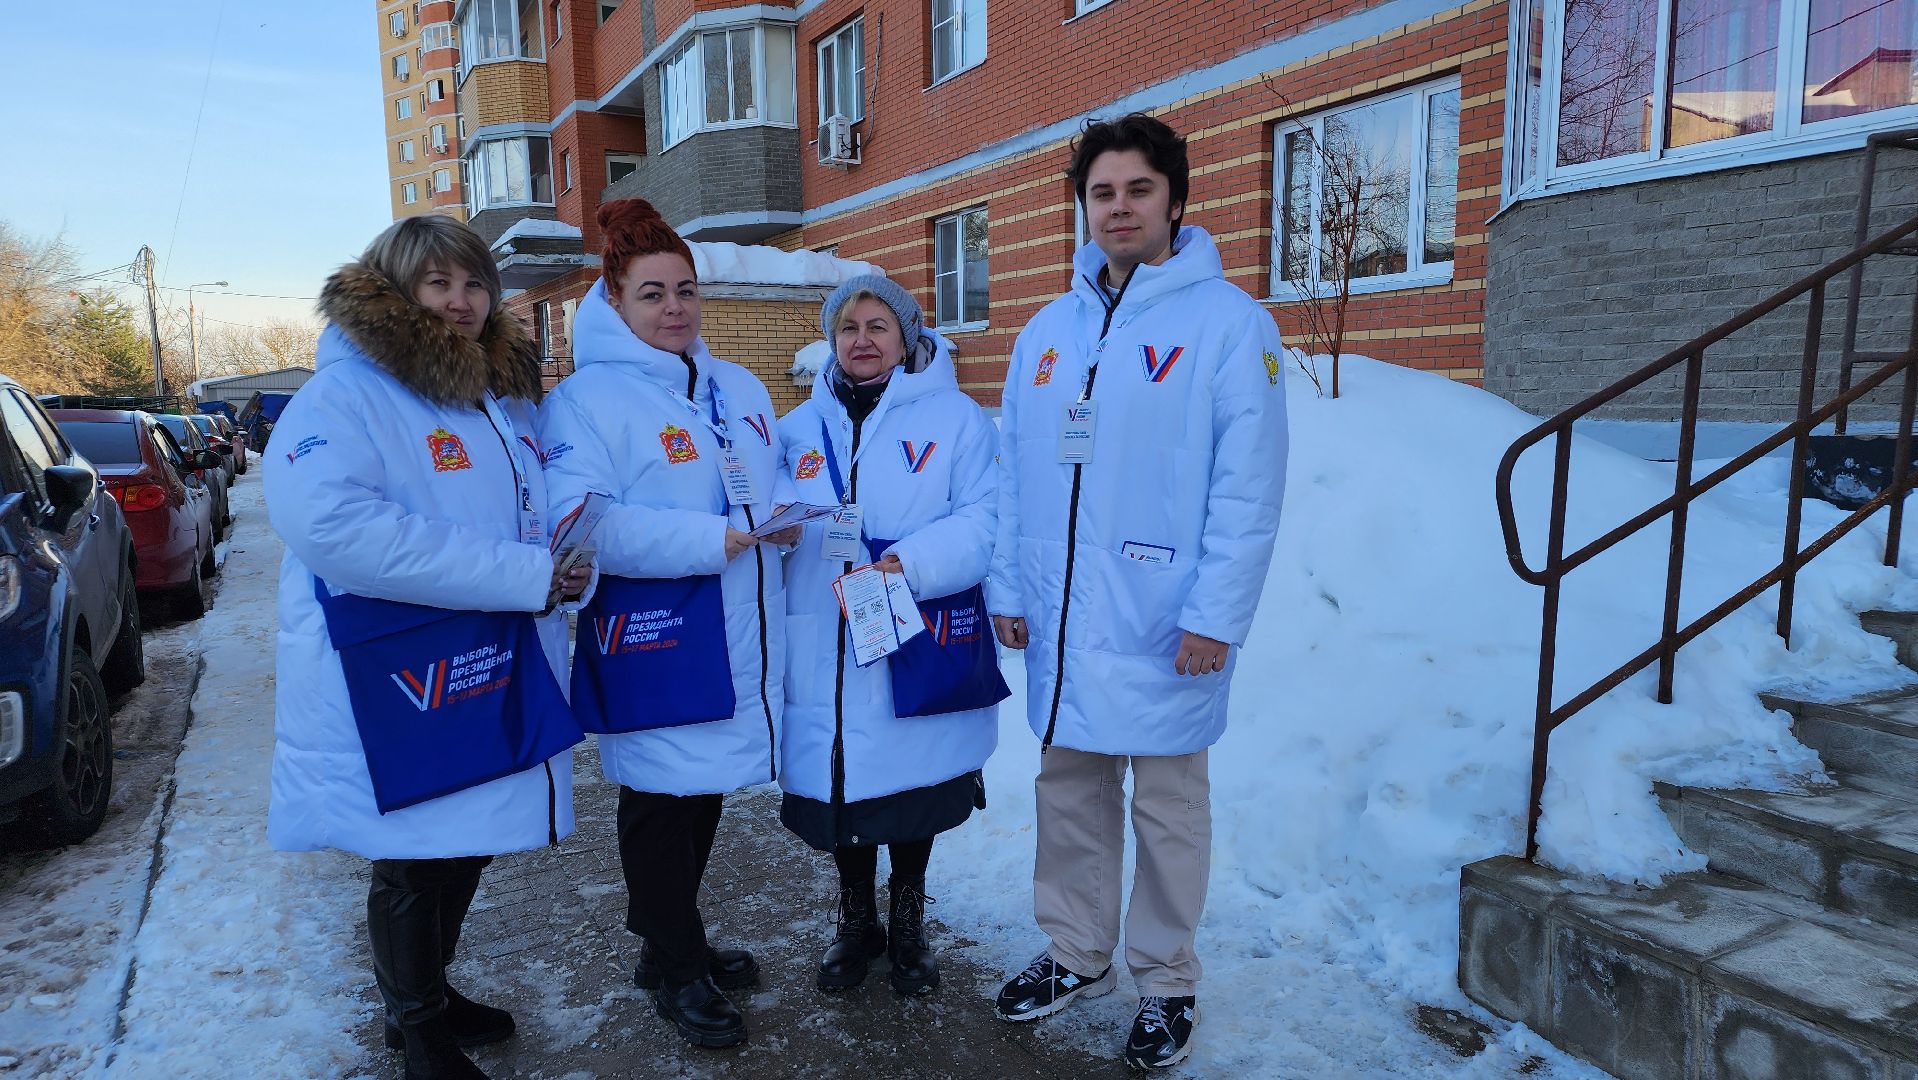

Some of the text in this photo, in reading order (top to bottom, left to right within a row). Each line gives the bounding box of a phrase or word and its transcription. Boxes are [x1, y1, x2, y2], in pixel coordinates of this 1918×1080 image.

[626, 616, 684, 634] ПРЕЗИДЕНТА
[630, 609, 673, 622] ВЫБОРЫ
[623, 631, 660, 645] РОССИИ
[450, 649, 513, 681] ПРЕЗИДЕНТА
[453, 643, 498, 667] ВЫБОРЫ
[448, 671, 491, 694] РОССИИ
